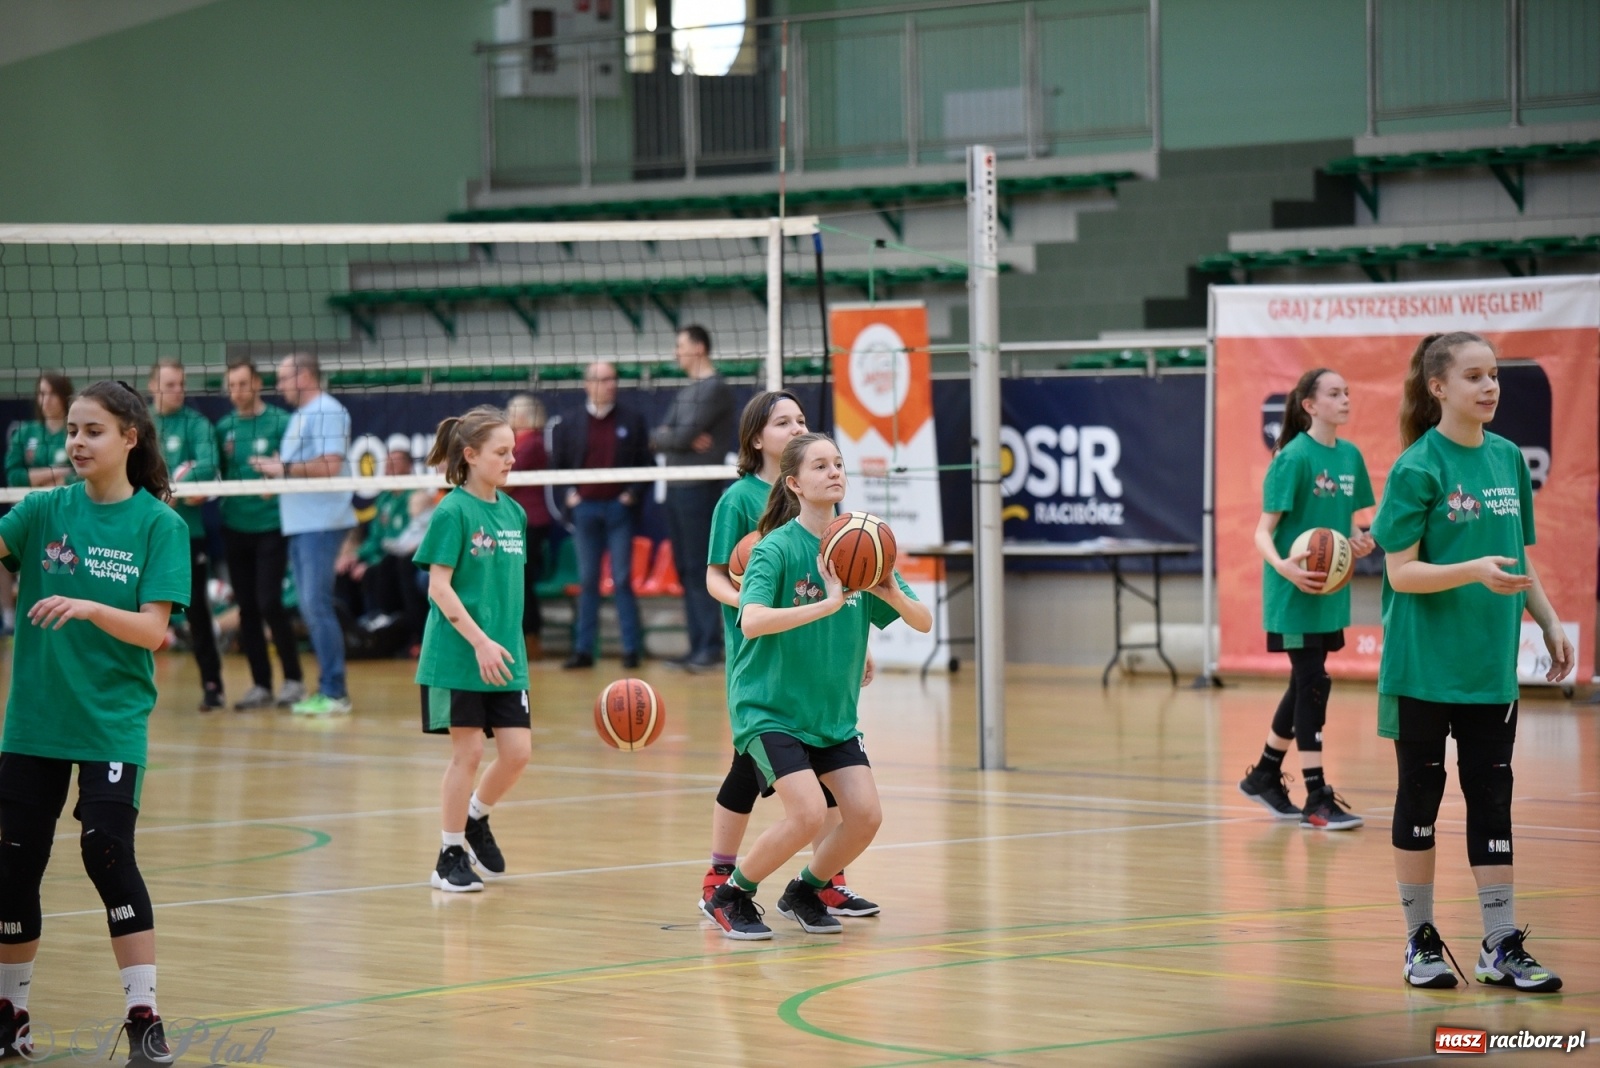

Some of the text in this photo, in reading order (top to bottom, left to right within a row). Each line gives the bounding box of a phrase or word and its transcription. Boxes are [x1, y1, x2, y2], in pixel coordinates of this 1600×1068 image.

[1267, 290, 1543, 324] GRAJ Z JASTRZĘBSKIM WĘGLEM!
[1482, 487, 1516, 497] WYBIERZ
[1034, 498, 1125, 525] RACIBÓRZ
[87, 545, 134, 562] WYBIERZ
[84, 557, 140, 578] WŁAŚCIWĄ
[634, 685, 646, 725] molten
[1495, 839, 1511, 853] NBA
[116, 904, 135, 921] NBA
[3, 921, 22, 934] NBA
